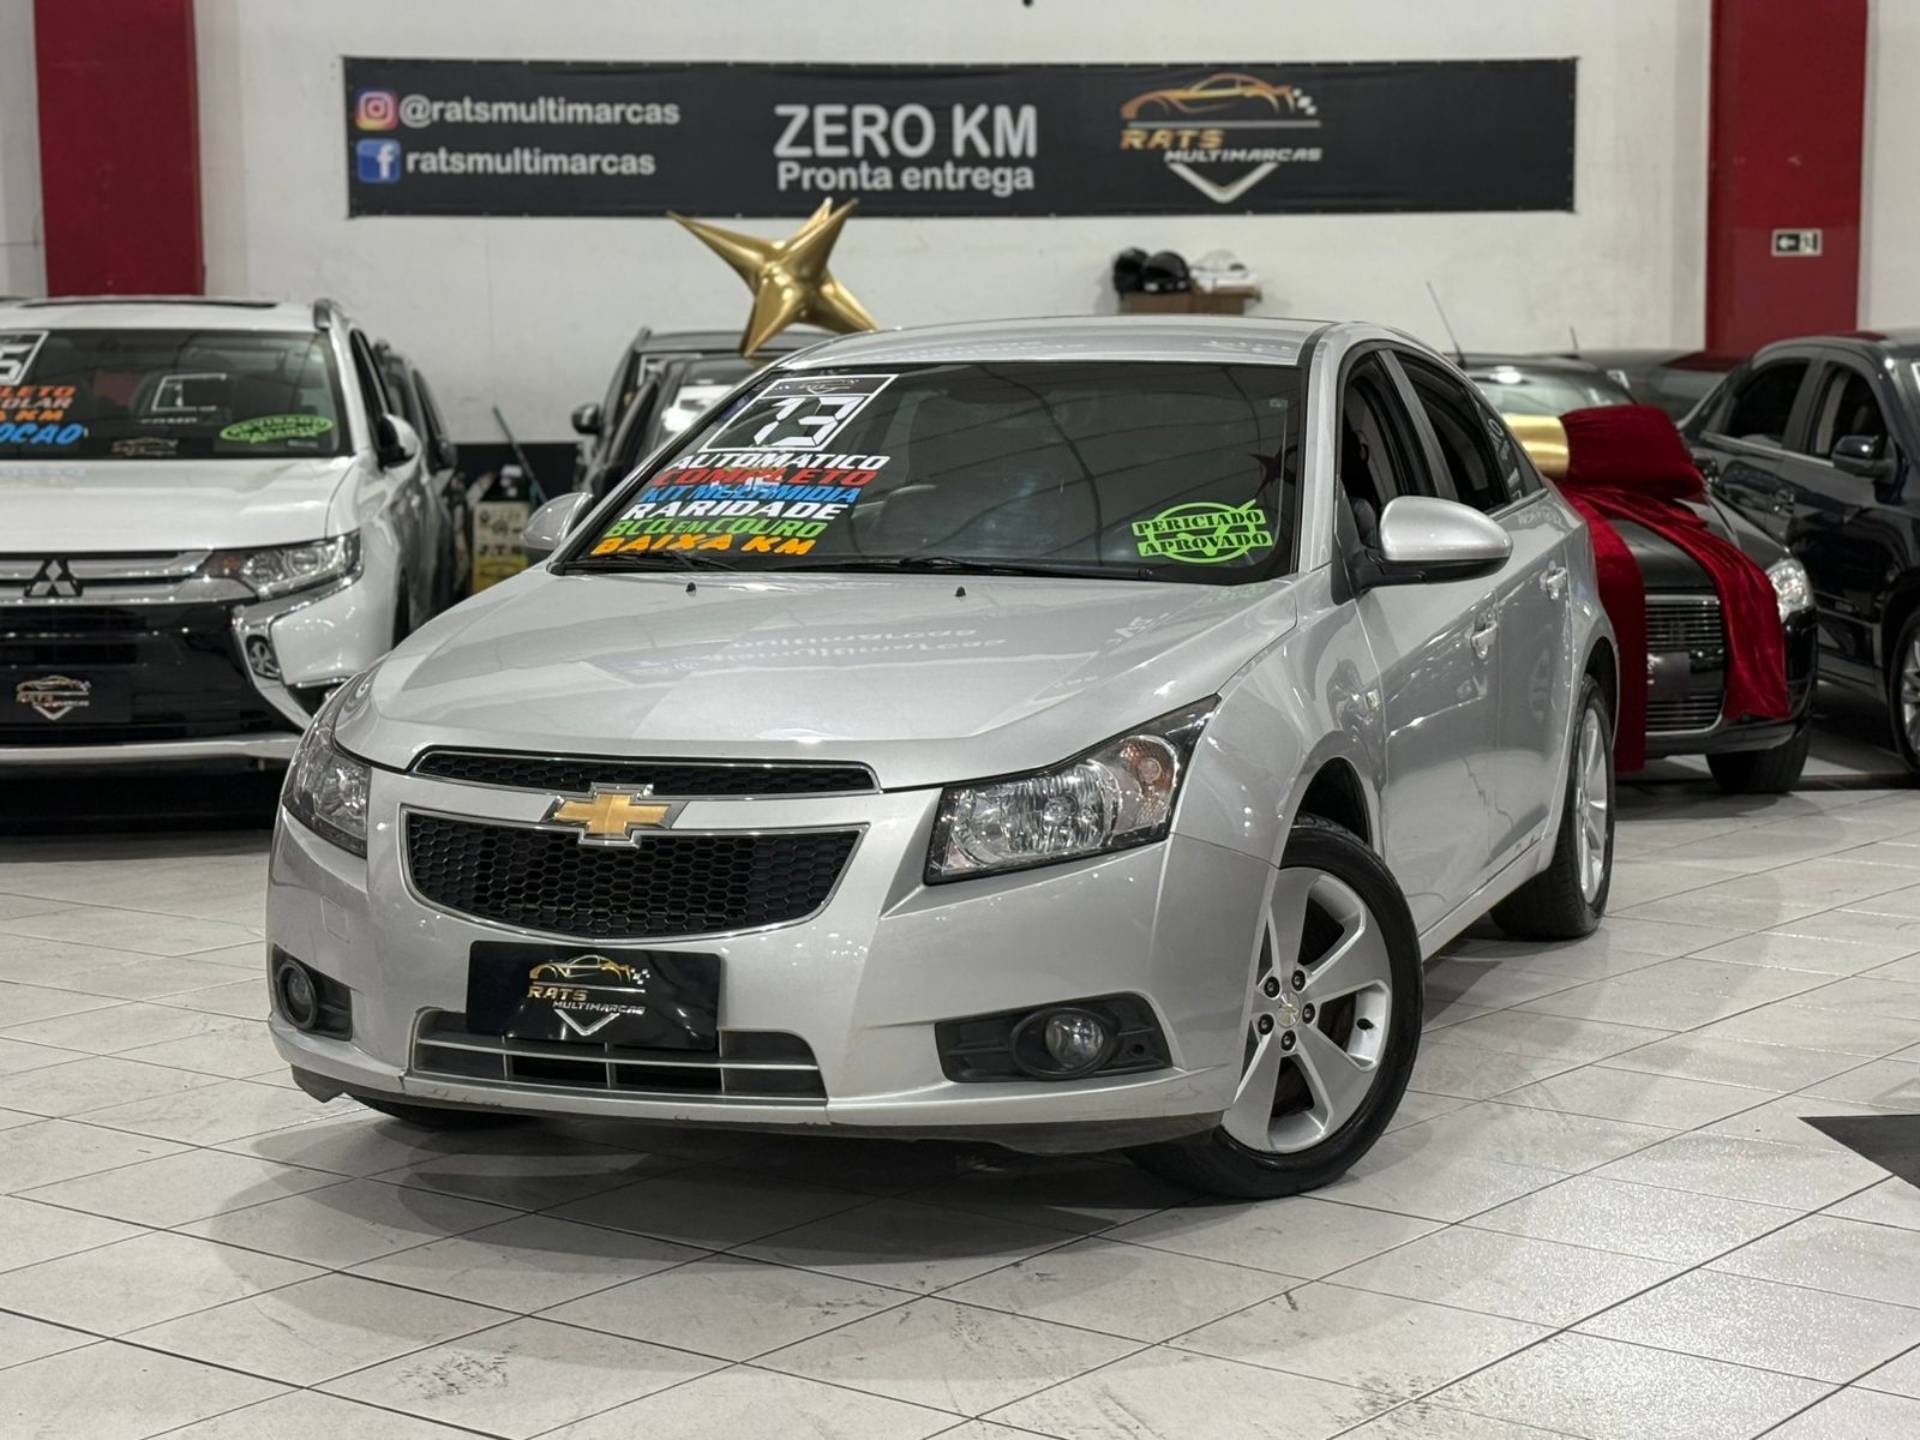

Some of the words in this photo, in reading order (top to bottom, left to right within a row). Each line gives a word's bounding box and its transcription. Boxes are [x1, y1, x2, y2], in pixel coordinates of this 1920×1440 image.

[400, 94, 680, 128] @ratsmultimarcas
[773, 103, 936, 159] ZERO
[952, 103, 1038, 159] KM
[1120, 129, 1225, 150] RATS
[406, 147, 656, 176] ratsmultimarcas
[1164, 148, 1322, 163] MULTIMARCAS
[777, 160, 894, 191] Pronta
[900, 160, 1035, 198] entrega
[753, 396, 866, 447] 13
[652, 466, 879, 487] COMPLETO
[638, 483, 690, 503] KIT
[620, 500, 849, 520] RARIDADE
[706, 517, 829, 538] COURO
[1136, 509, 1263, 536] PERICIADO
[590, 533, 734, 555] BAIXA
[740, 535, 817, 556] KM
[1143, 532, 1270, 555] APROVADO
[527, 985, 589, 1001] RATS
[552, 1001, 647, 1016] MULTIMARCAS
